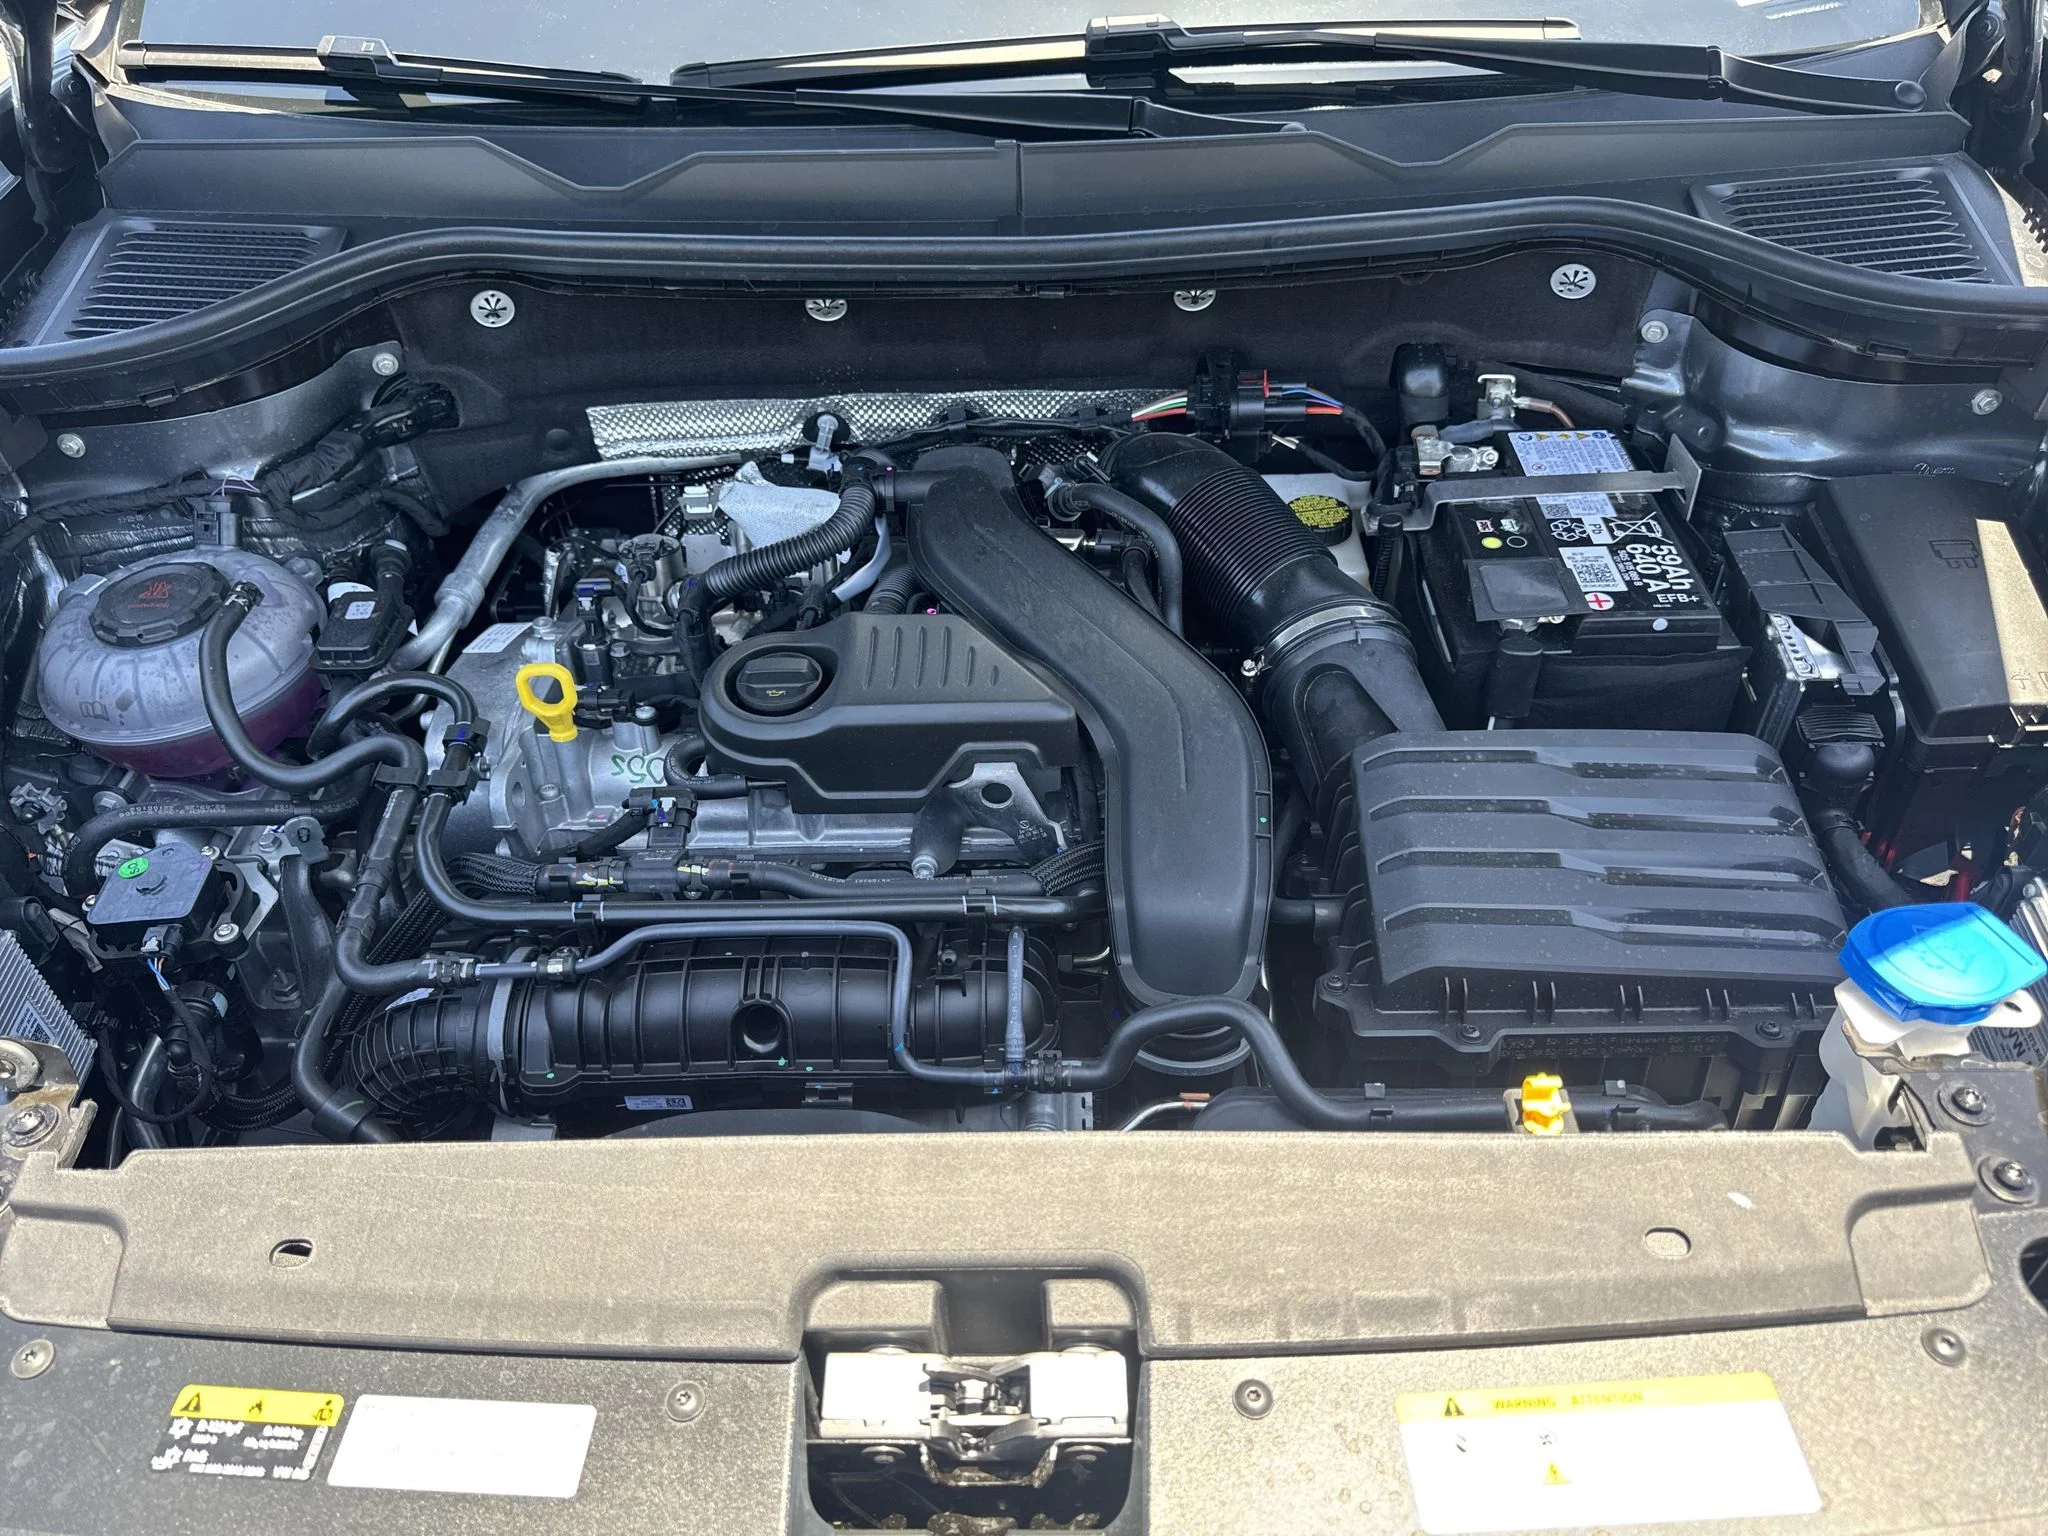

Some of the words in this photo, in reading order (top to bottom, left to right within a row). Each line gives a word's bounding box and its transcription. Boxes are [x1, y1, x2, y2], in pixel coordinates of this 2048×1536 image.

[1589, 522, 1602, 536] Pb
[1625, 543, 1662, 574] 640
[1651, 545, 1695, 590] 59Ah
[1642, 578, 1671, 593] A
[1656, 593, 1700, 603] EFB+
[1493, 1396, 1556, 1410] WARNING
